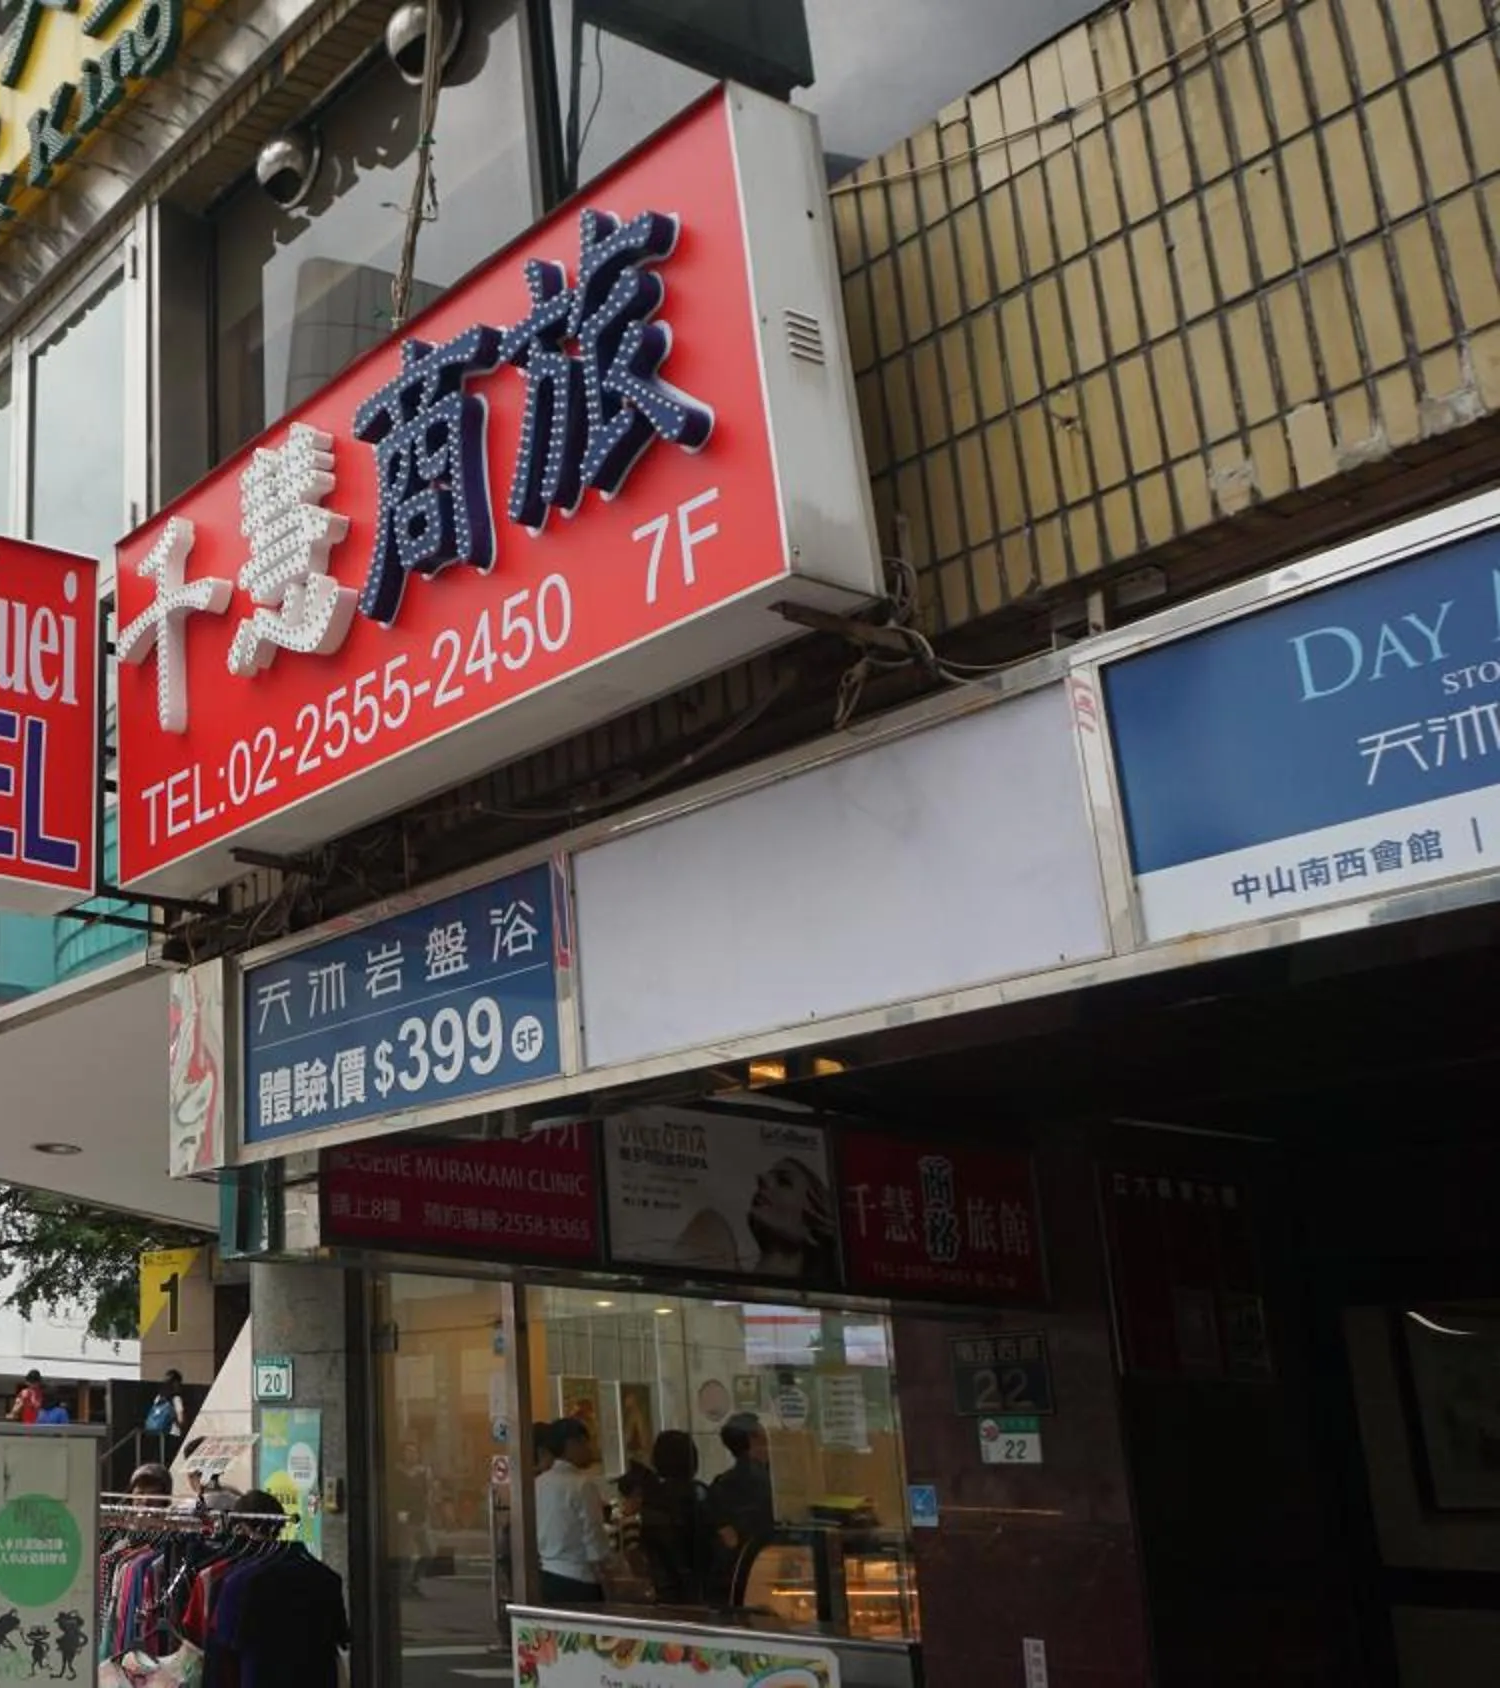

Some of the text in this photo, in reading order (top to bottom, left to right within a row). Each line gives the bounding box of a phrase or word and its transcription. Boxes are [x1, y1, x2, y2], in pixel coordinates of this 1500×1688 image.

[27, 0, 182, 188] King
[117, 208, 713, 733] 千慧商旅
[140, 488, 720, 846] TEL:02-2555-2450 7F
[1287, 600, 1454, 701] DAY
[1232, 829, 1444, 904] 中山南西會館
[257, 900, 539, 1035] 天沐岩盤浴
[259, 997, 540, 1127] 體驗價 $399 5F
[416, 1155, 524, 1189] MURAKAMI
[528, 1168, 589, 1197] CLINIC
[160, 1271, 180, 1334] 1
[264, 1373, 283, 1393] 20
[973, 1368, 1035, 1411] 22
[1004, 1440, 1027, 1460] 22
